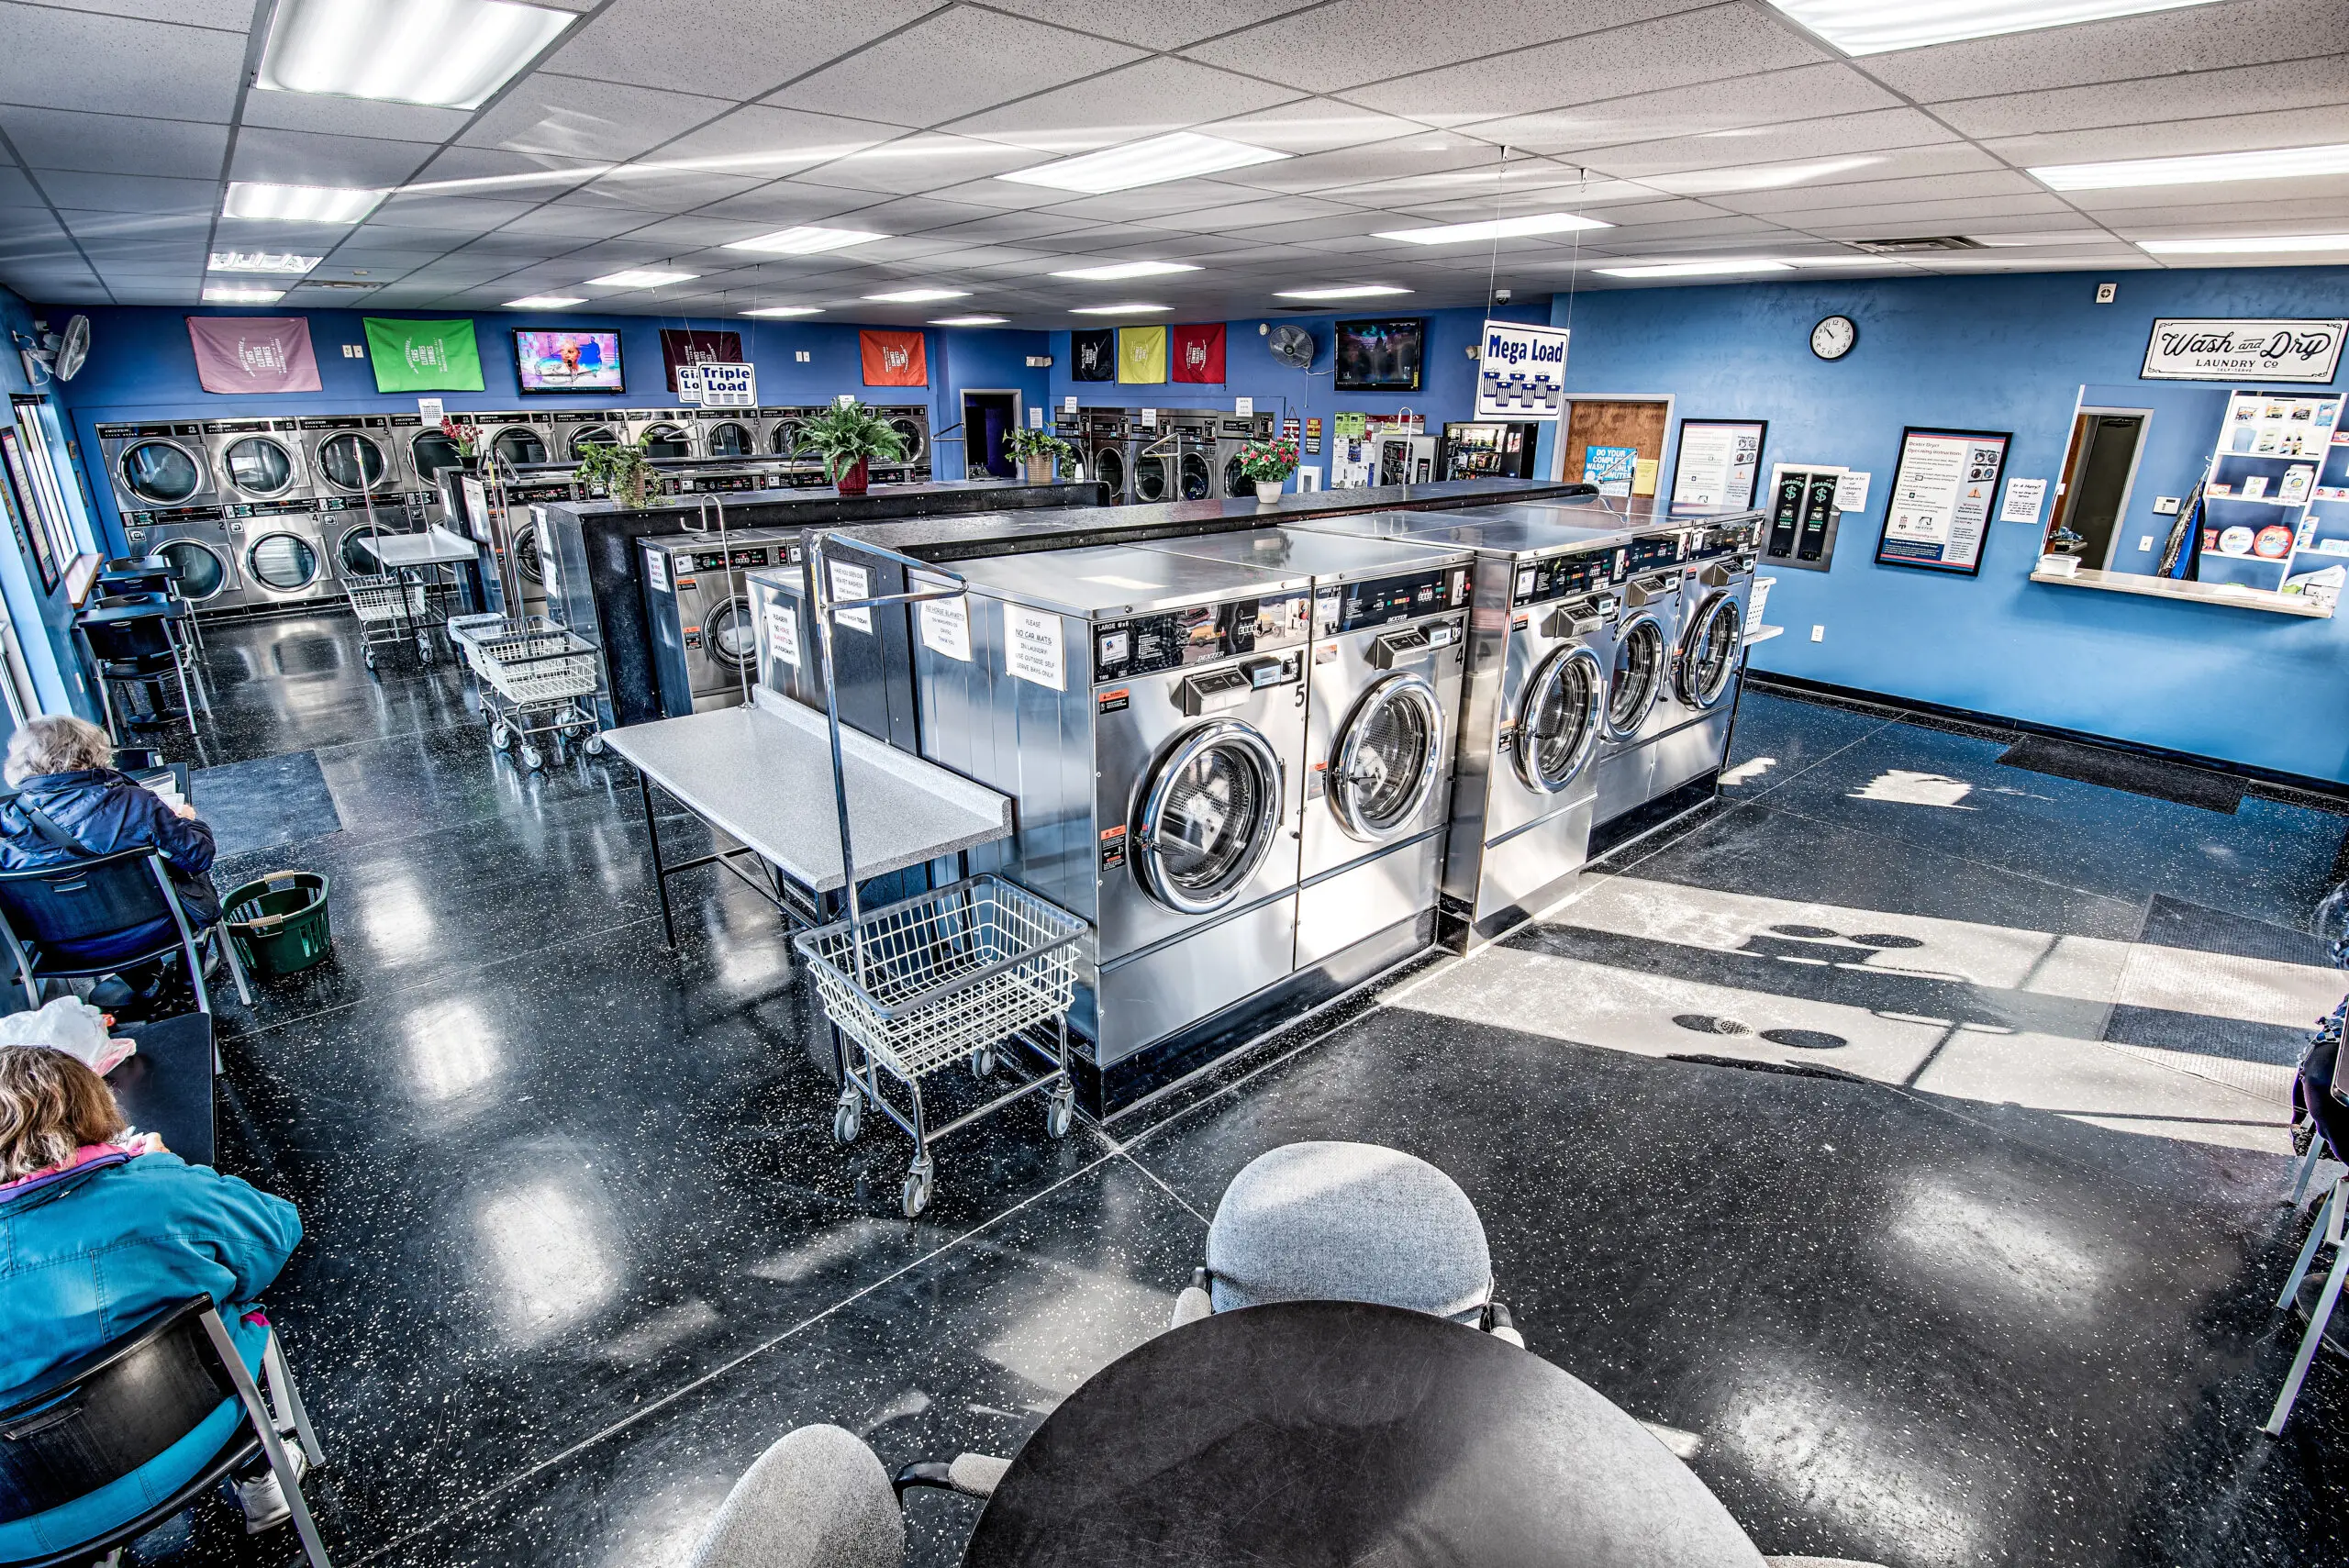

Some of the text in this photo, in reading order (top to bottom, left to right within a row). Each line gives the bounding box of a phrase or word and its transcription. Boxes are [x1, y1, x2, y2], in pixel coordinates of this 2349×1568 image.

[1487, 334, 1564, 364] Mega Load
[2161, 331, 2332, 361] Wash and Dry
[2195, 359, 2256, 368] LAUNDRY
[701, 367, 751, 381] Triple
[684, 381, 699, 389] Lo
[707, 381, 747, 392] Load
[383, 427, 390, 436] 5
[1607, 450, 1626, 458] YOUR
[1586, 462, 1605, 471] WASH
[400, 507, 406, 516] 6
[312, 514, 318, 522] 4
[218, 522, 226, 530] 2
[1565, 587, 1582, 596] DEXTER
[1674, 590, 1681, 607] 2
[931, 606, 945, 616] HORSE
[1025, 618, 1041, 628] PLEASE
[1386, 614, 1408, 623] DEXTER
[1097, 622, 1116, 631] LARGE
[1015, 628, 1052, 645] NO CAR MATS
[1611, 623, 1619, 641] 3
[1197, 651, 1225, 662] DEXTER
[1454, 645, 1464, 665] 4
[1015, 652, 1055, 669] USE OUTSIDE SELF
[1017, 662, 1029, 672] SERVE
[1030, 665, 1041, 674] BAYS
[1295, 683, 1306, 707] 5
